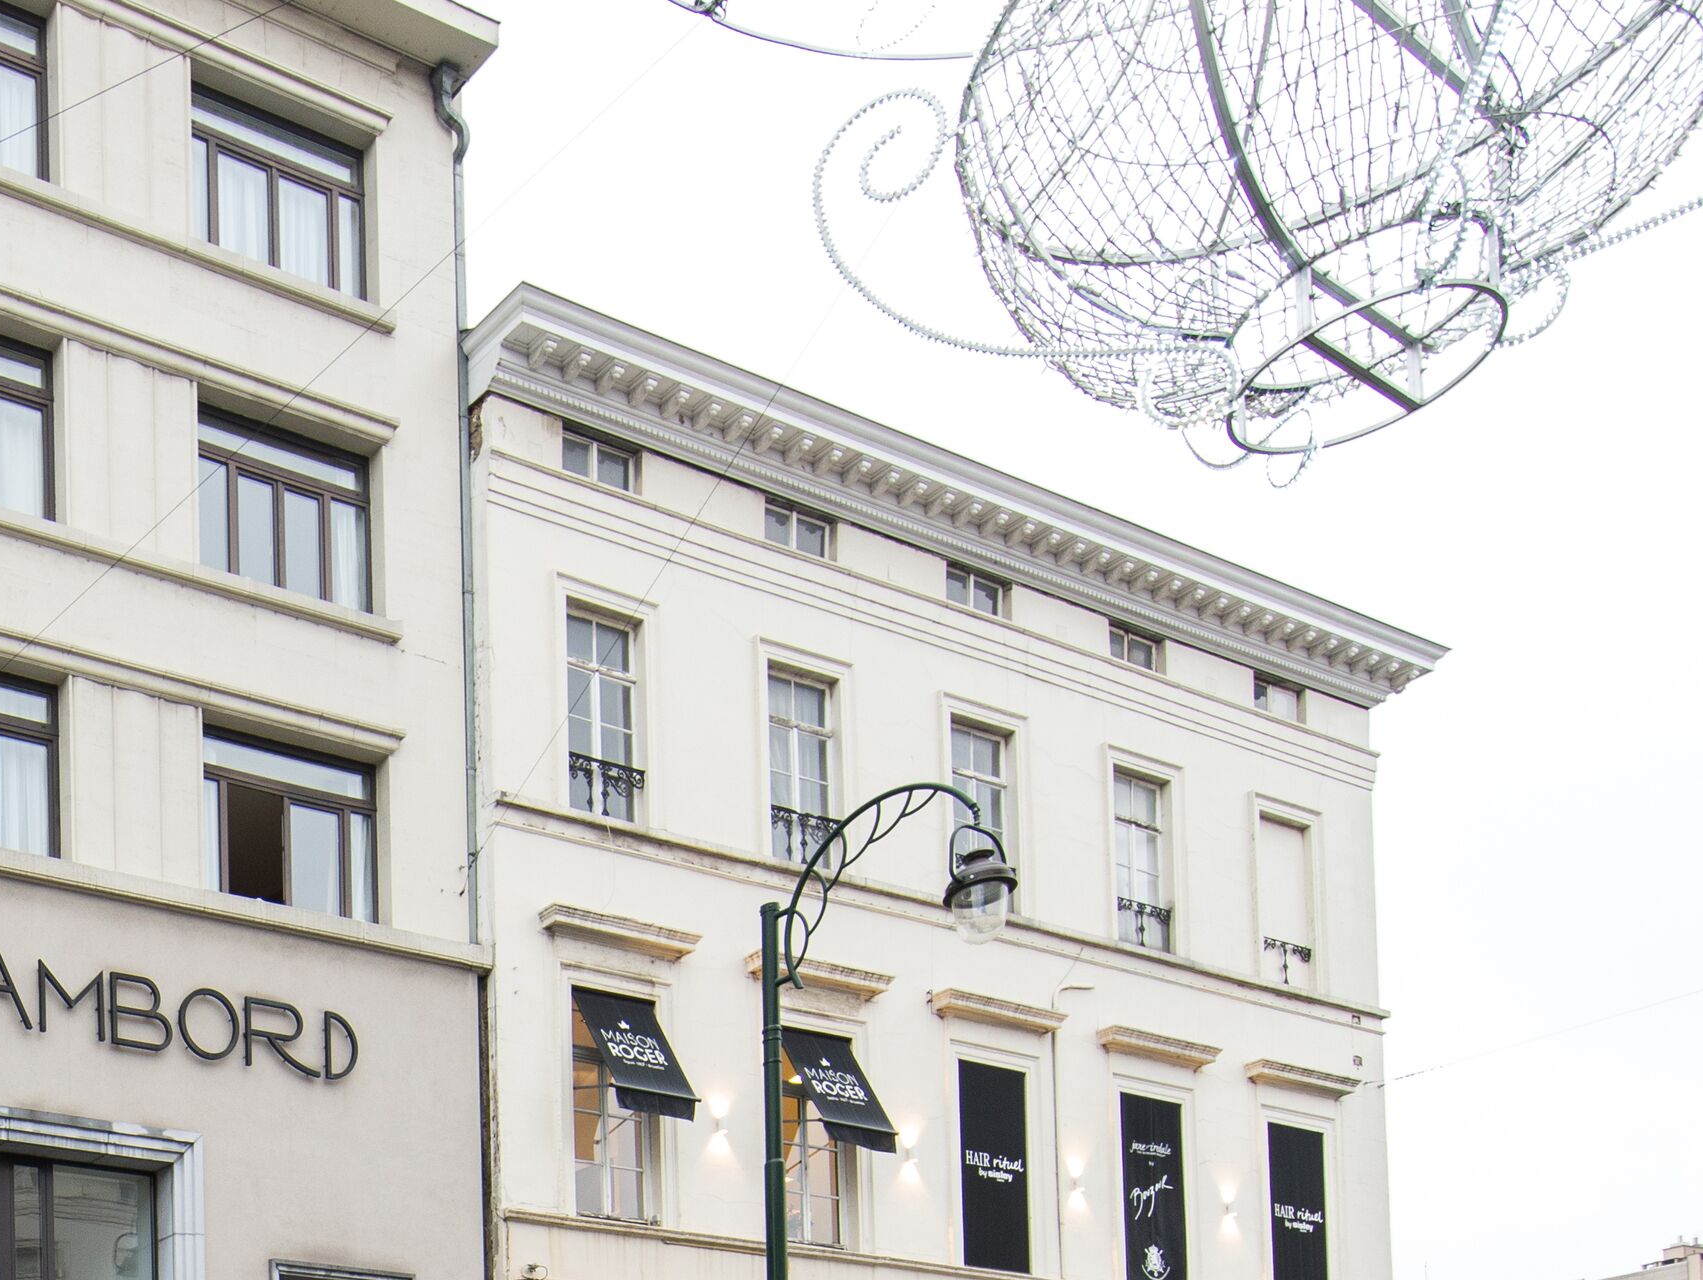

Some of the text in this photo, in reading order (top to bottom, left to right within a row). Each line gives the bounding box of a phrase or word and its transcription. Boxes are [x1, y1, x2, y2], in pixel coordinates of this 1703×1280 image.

[600, 1028, 660, 1050] MAISON
[606, 1042, 669, 1066] ROGER
[804, 1066, 859, 1086] MAISON
[811, 1079, 869, 1101] ROGER
[965, 1149, 1025, 1173] HAIR rituel
[978, 1166, 988, 1179] by
[1274, 1202, 1324, 1224] HAIR rituel
[1284, 1219, 1293, 1230] by
